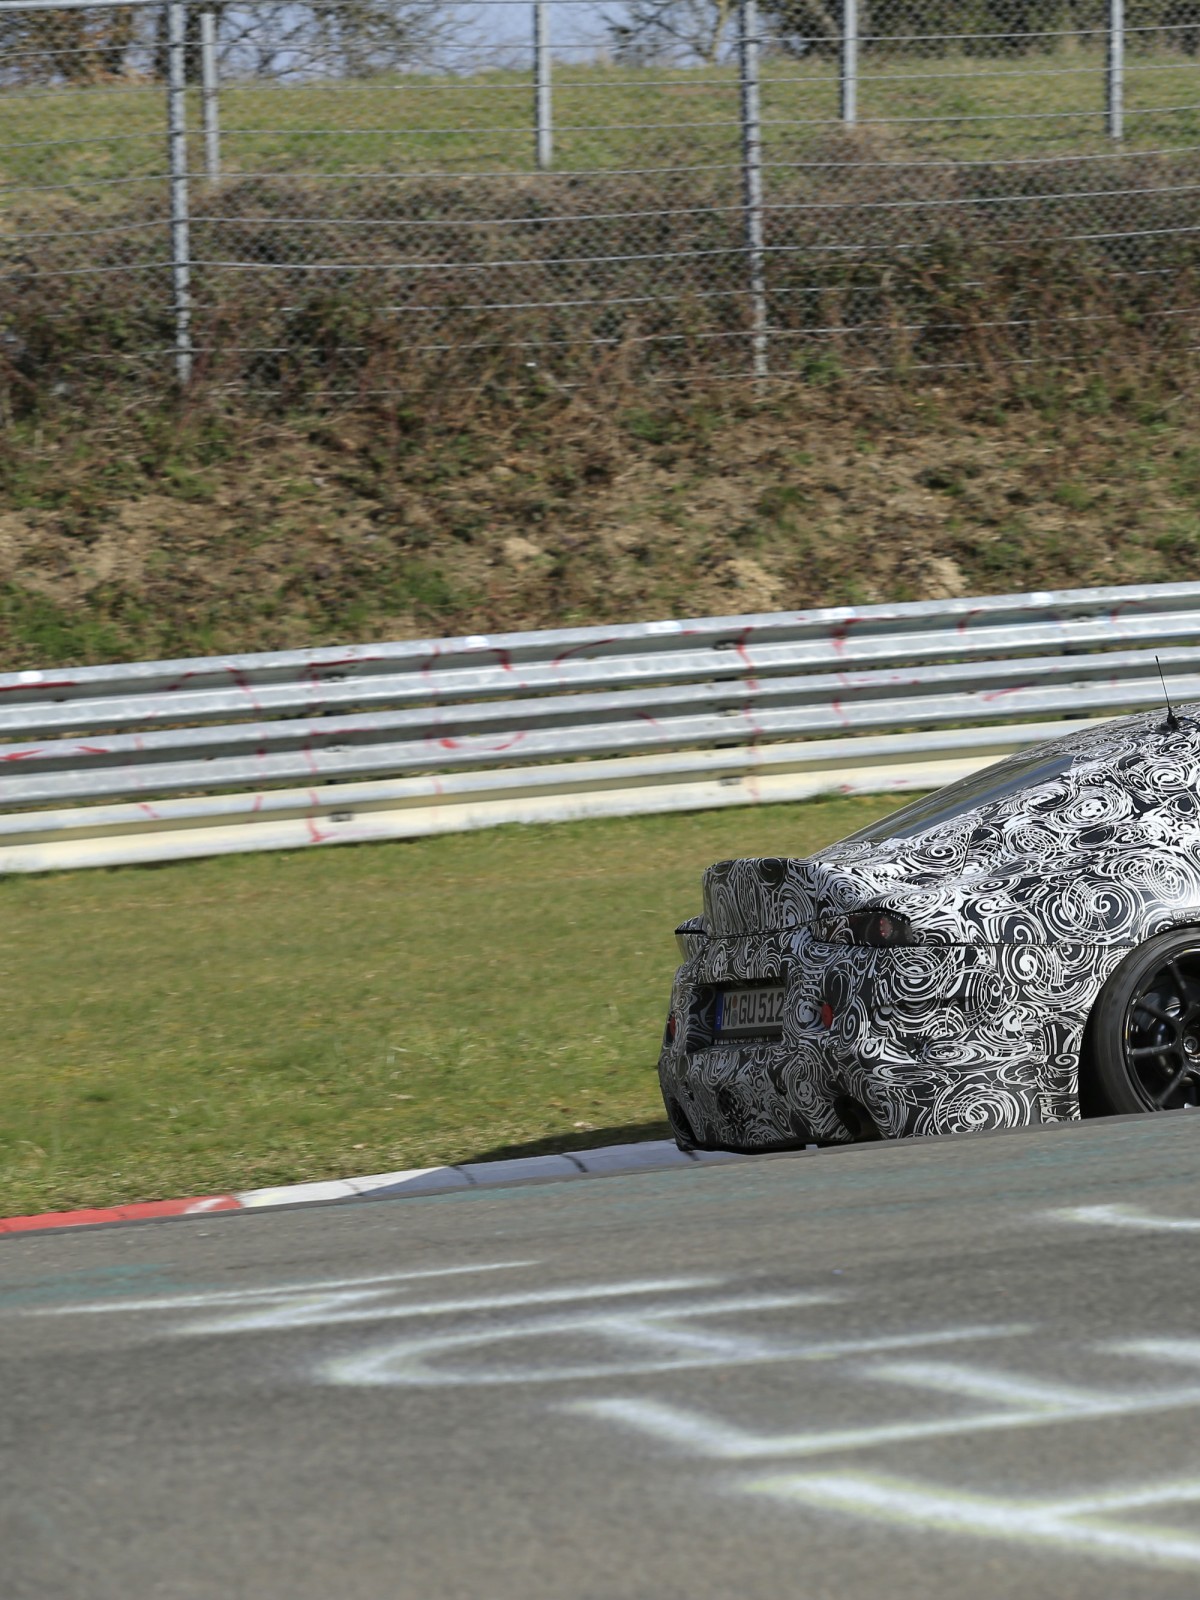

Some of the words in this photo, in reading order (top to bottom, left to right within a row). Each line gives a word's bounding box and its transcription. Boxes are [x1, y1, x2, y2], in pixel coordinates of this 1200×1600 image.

[722, 995, 732, 1027] M
[739, 993, 757, 1025] GU
[758, 991, 785, 1023] 512
